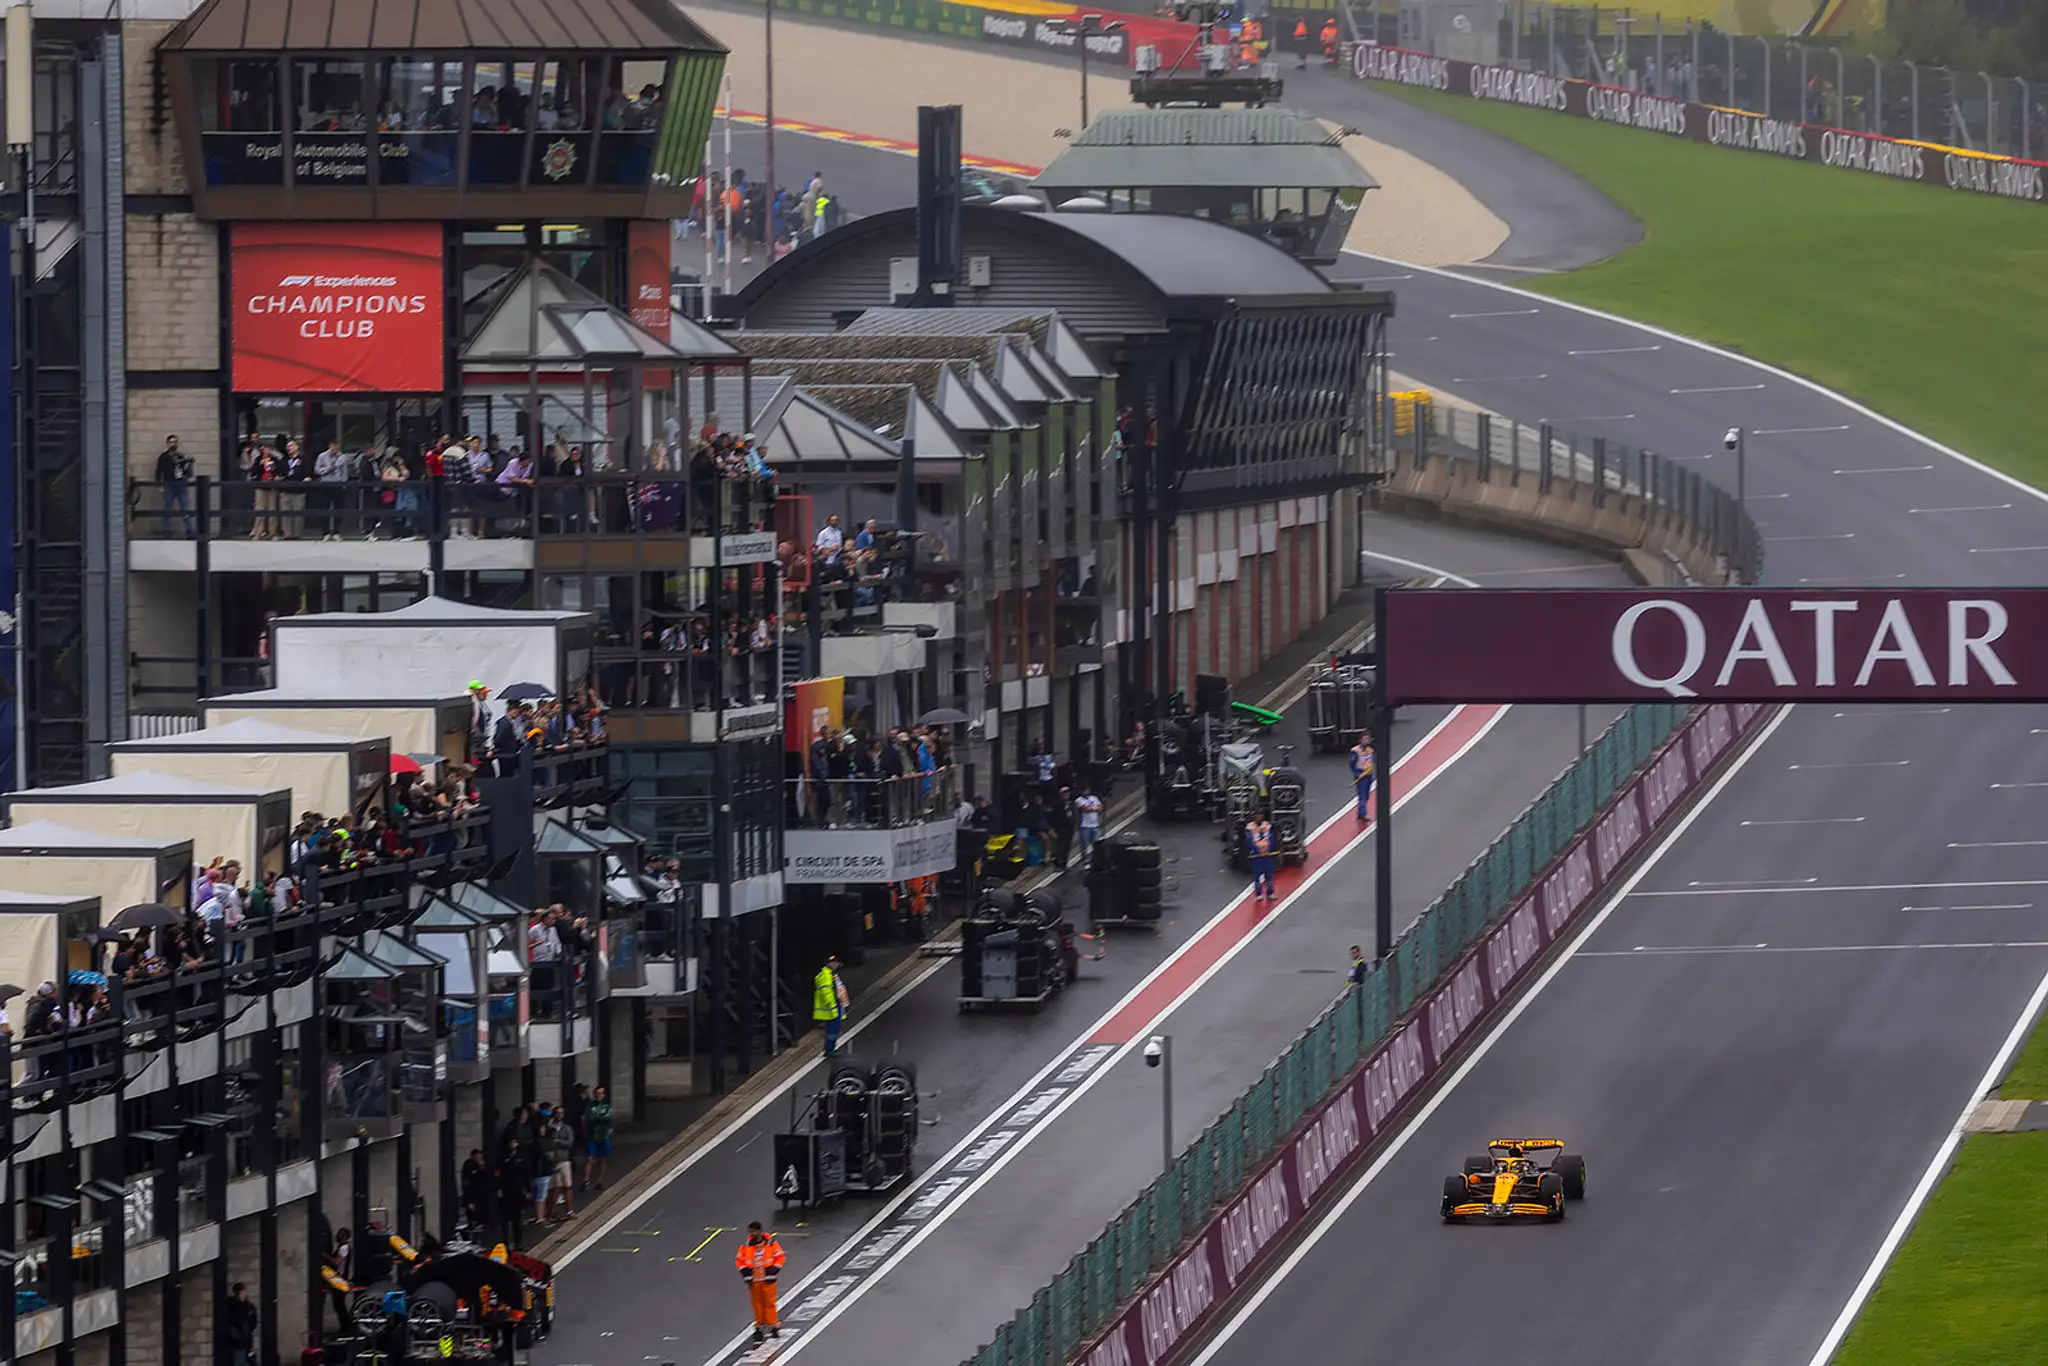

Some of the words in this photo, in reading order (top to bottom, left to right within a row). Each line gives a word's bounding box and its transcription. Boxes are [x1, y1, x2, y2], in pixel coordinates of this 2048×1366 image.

[1353, 44, 1398, 81] QATAR
[1469, 64, 1512, 101] QATAR
[1586, 85, 1631, 124] QATAR
[1707, 109, 1749, 147] QATAR
[245, 142, 282, 160] Royal
[293, 142, 368, 158] Automobile
[379, 142, 409, 158] Club
[1820, 130, 1866, 169] QATAR
[296, 161, 311, 177] of
[313, 161, 366, 179] Belgium
[1944, 153, 1989, 191] QATAR
[314, 275, 397, 289] Experiences
[247, 295, 427, 314] CHAMPIONS
[300, 319, 374, 338] CLUB
[1611, 598, 2018, 698] QATAR
[795, 855, 840, 868] CIRCUIT
[842, 855, 860, 868] DE
[863, 855, 885, 868] SPA
[795, 867, 888, 879] FRANCORCHAMPS
